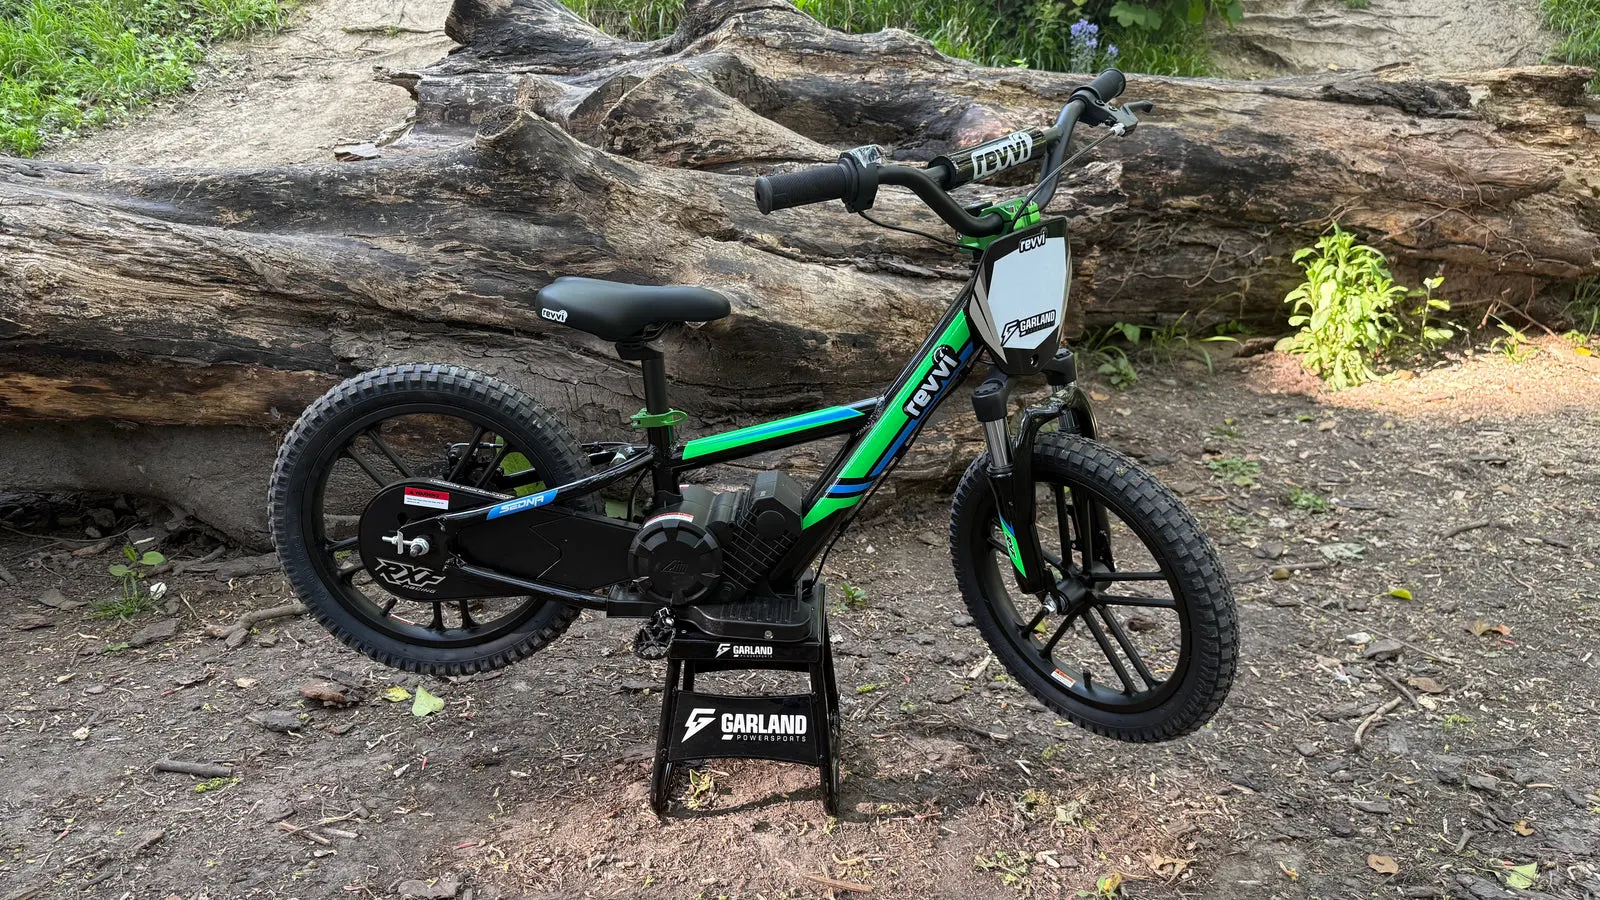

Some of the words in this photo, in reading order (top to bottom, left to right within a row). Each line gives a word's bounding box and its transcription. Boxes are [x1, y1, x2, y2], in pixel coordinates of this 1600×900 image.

[973, 137, 1029, 177] revvi
[1019, 231, 1045, 252] revvi
[542, 309, 566, 322] revvi
[1020, 311, 1055, 332] GARLAND
[904, 350, 958, 417] revvi
[499, 495, 545, 514] SEDNA
[375, 557, 446, 587] RXF
[733, 645, 773, 655] GARLAND
[721, 713, 807, 735] GARLAND
[736, 734, 807, 743] POWERSPORTS
